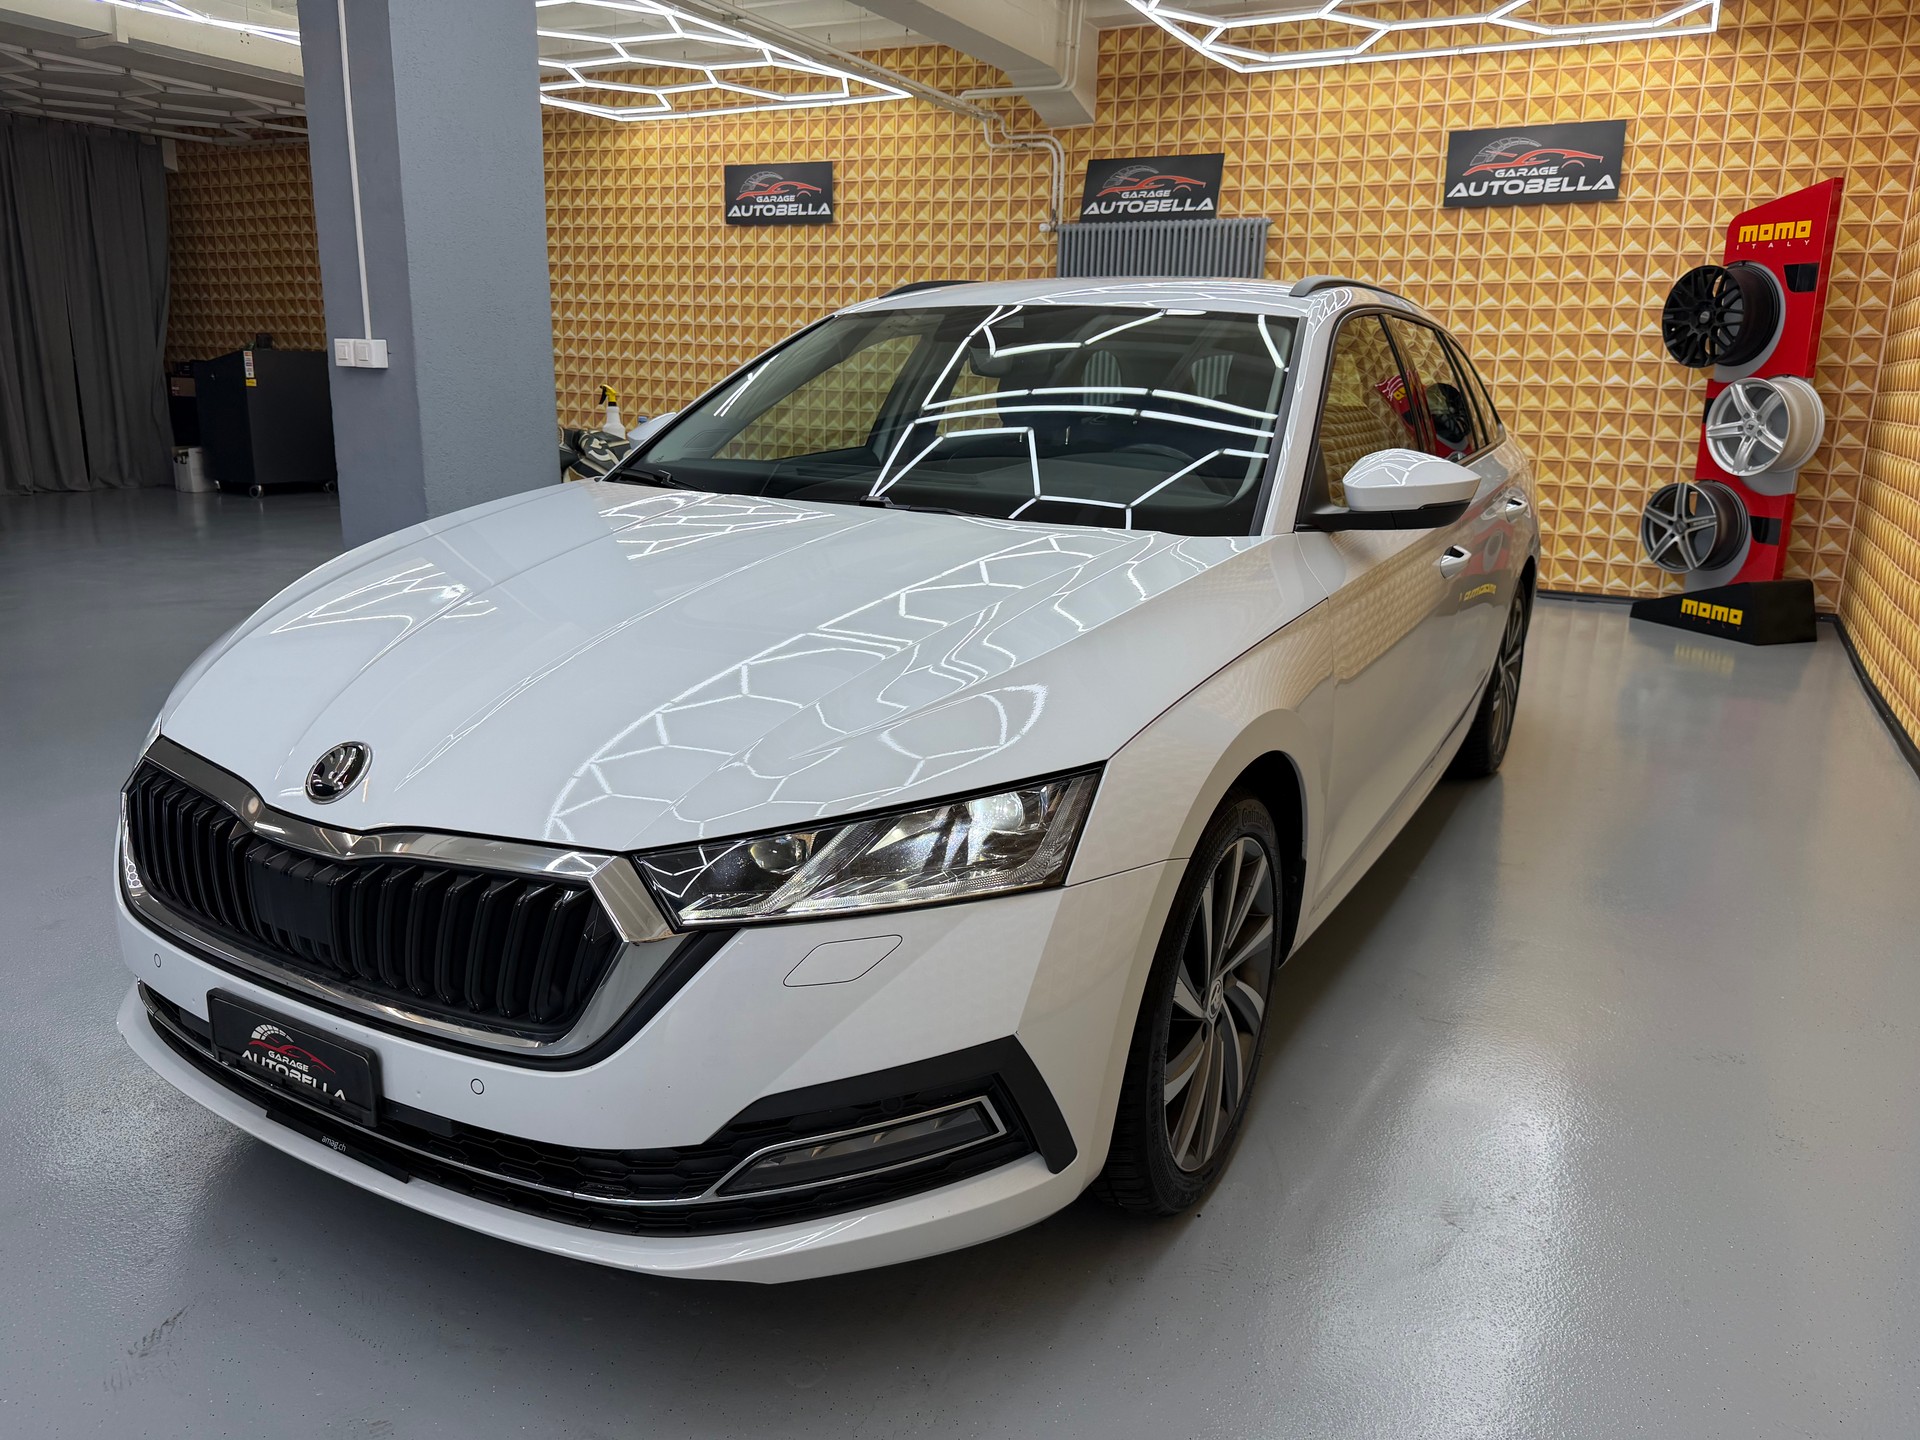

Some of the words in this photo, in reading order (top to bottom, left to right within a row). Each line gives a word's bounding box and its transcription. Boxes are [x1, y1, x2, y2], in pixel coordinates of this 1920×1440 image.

[1494, 166, 1559, 178] GARAGE
[1446, 174, 1616, 198] AUTOBELLA
[756, 195, 796, 203] GARAGE
[1121, 189, 1172, 199] GARAGE
[727, 202, 831, 217] AUTOBELLA
[1083, 197, 1214, 215] AUTOBELLA
[1736, 239, 1810, 251] ITALY
[268, 1050, 309, 1073] GARAGE
[321, 1135, 346, 1152] amag.ch
